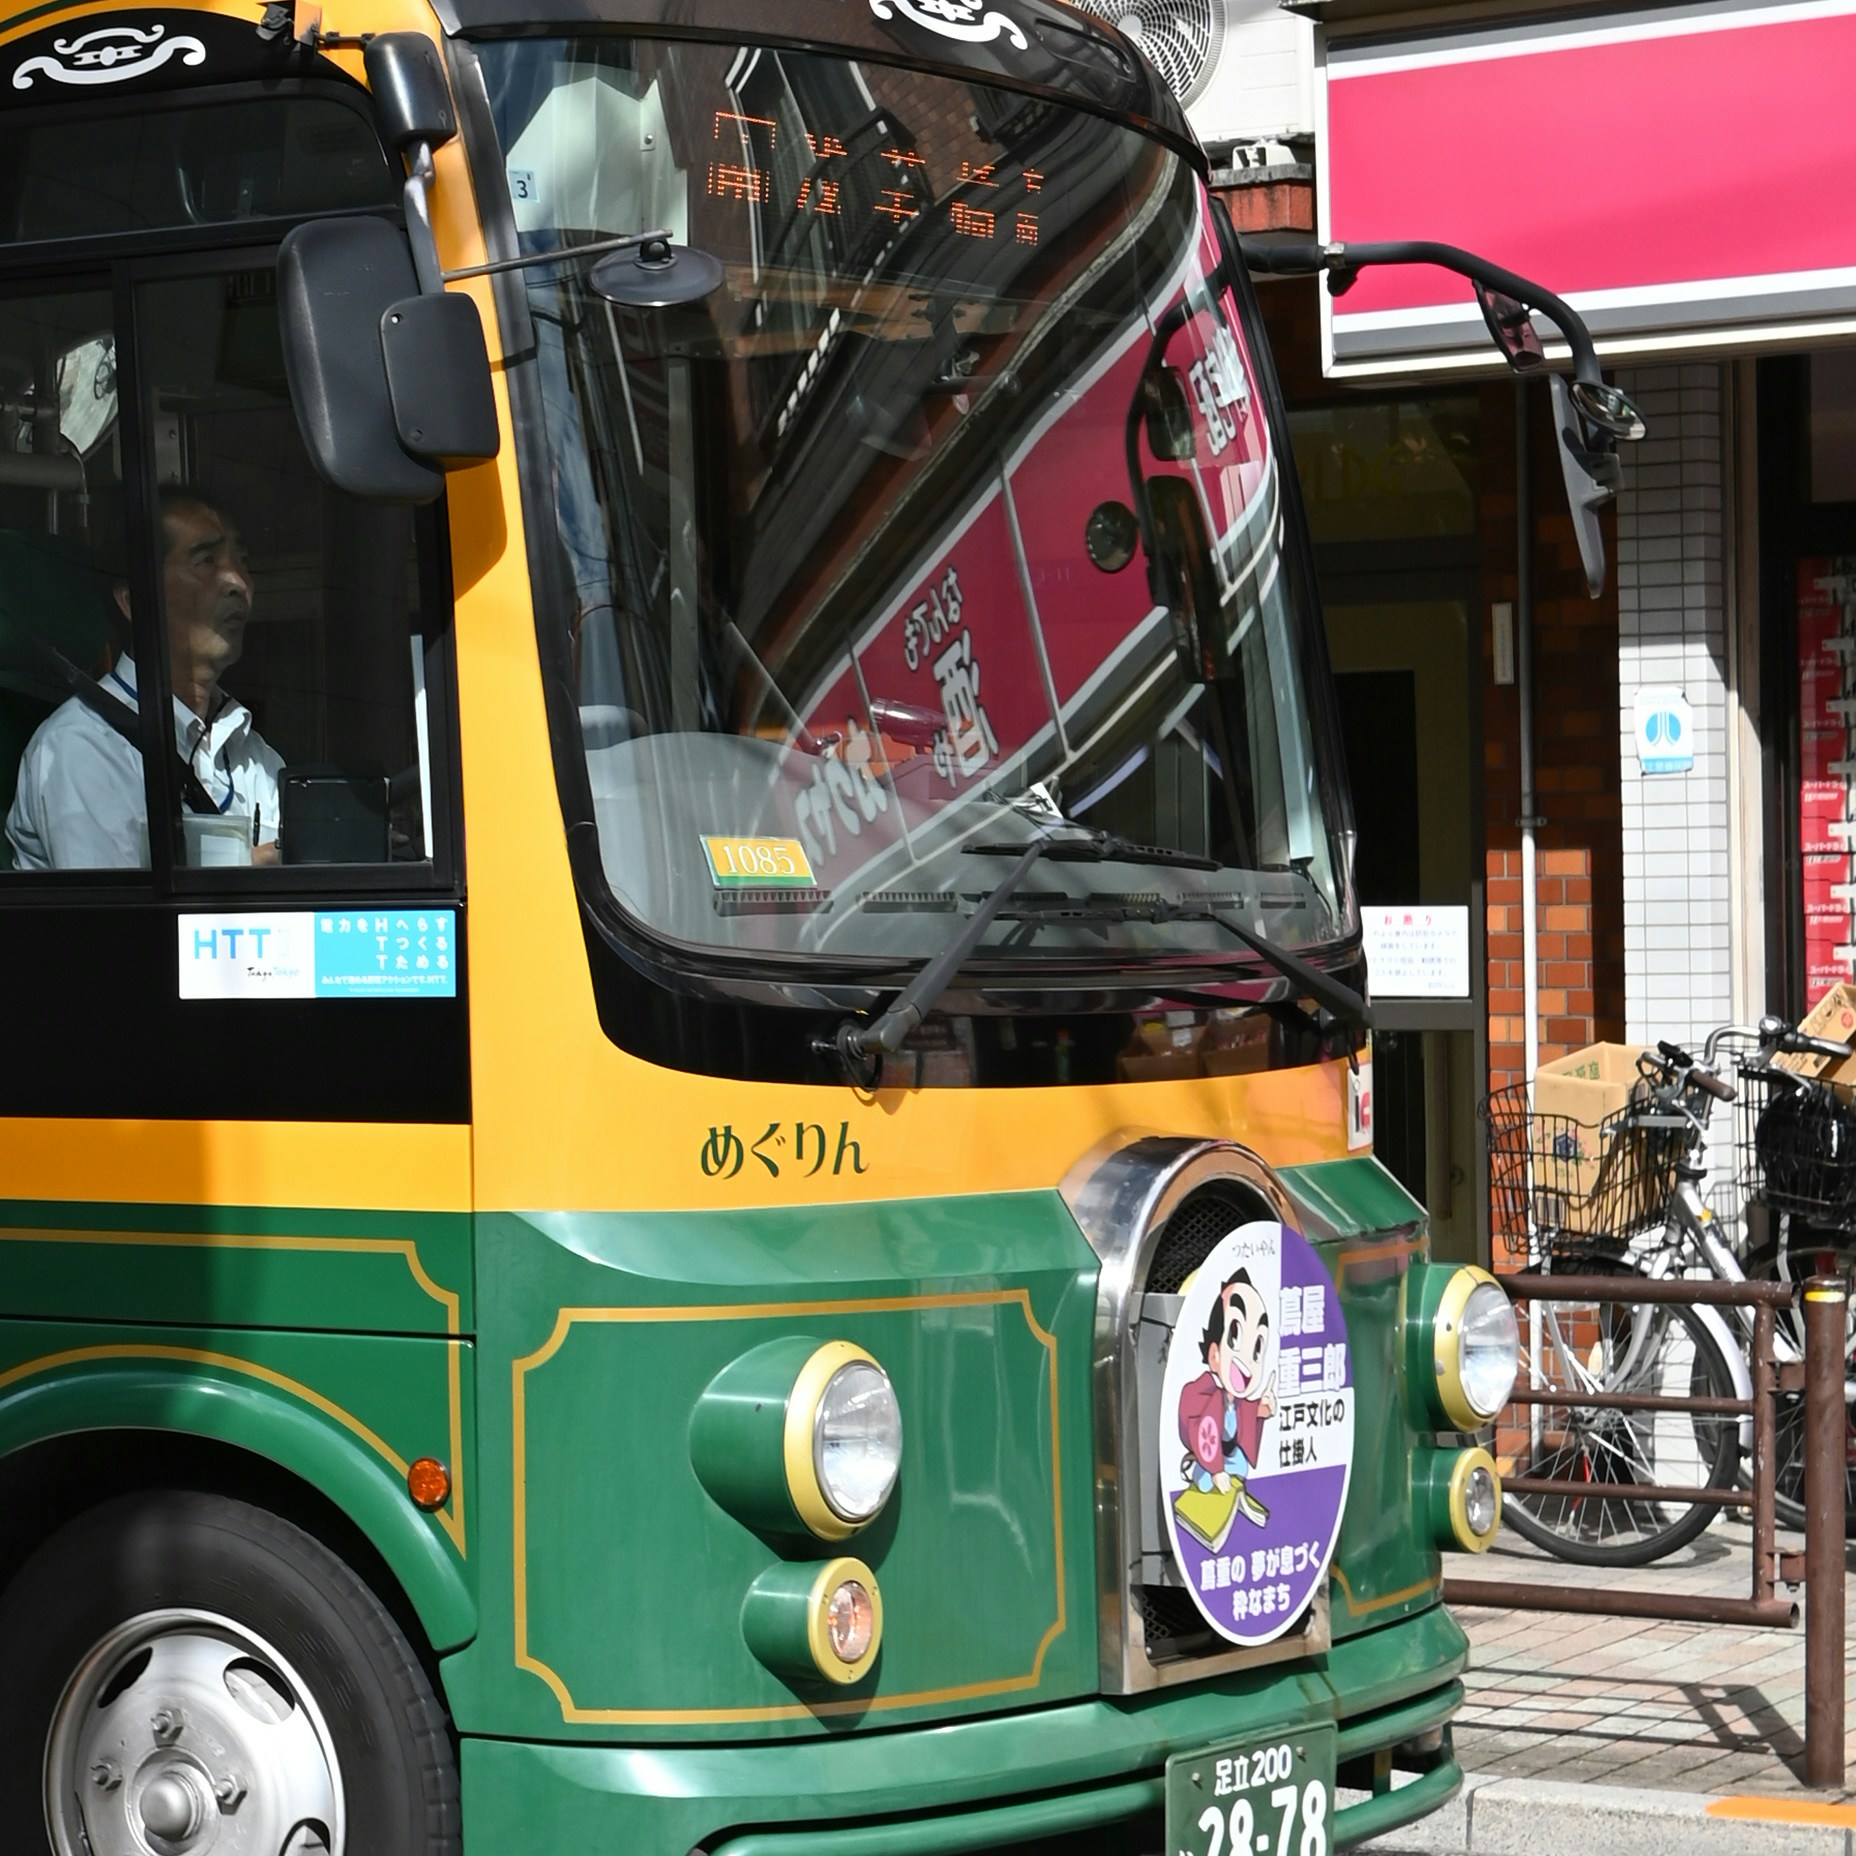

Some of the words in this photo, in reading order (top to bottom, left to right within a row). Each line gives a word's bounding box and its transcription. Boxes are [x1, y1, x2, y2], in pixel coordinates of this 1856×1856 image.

[723, 845, 795, 874] 1085
[194, 929, 271, 959] HTT
[700, 1121, 870, 1179] めぐりん
[1279, 1285, 1326, 1336] 蔦屋
[1278, 1343, 1346, 1398] 重三郎
[1279, 1398, 1345, 1431] 江戸文化の
[1279, 1436, 1317, 1468] 仕掛人
[1232, 1582, 1290, 1621] 粋なまち
